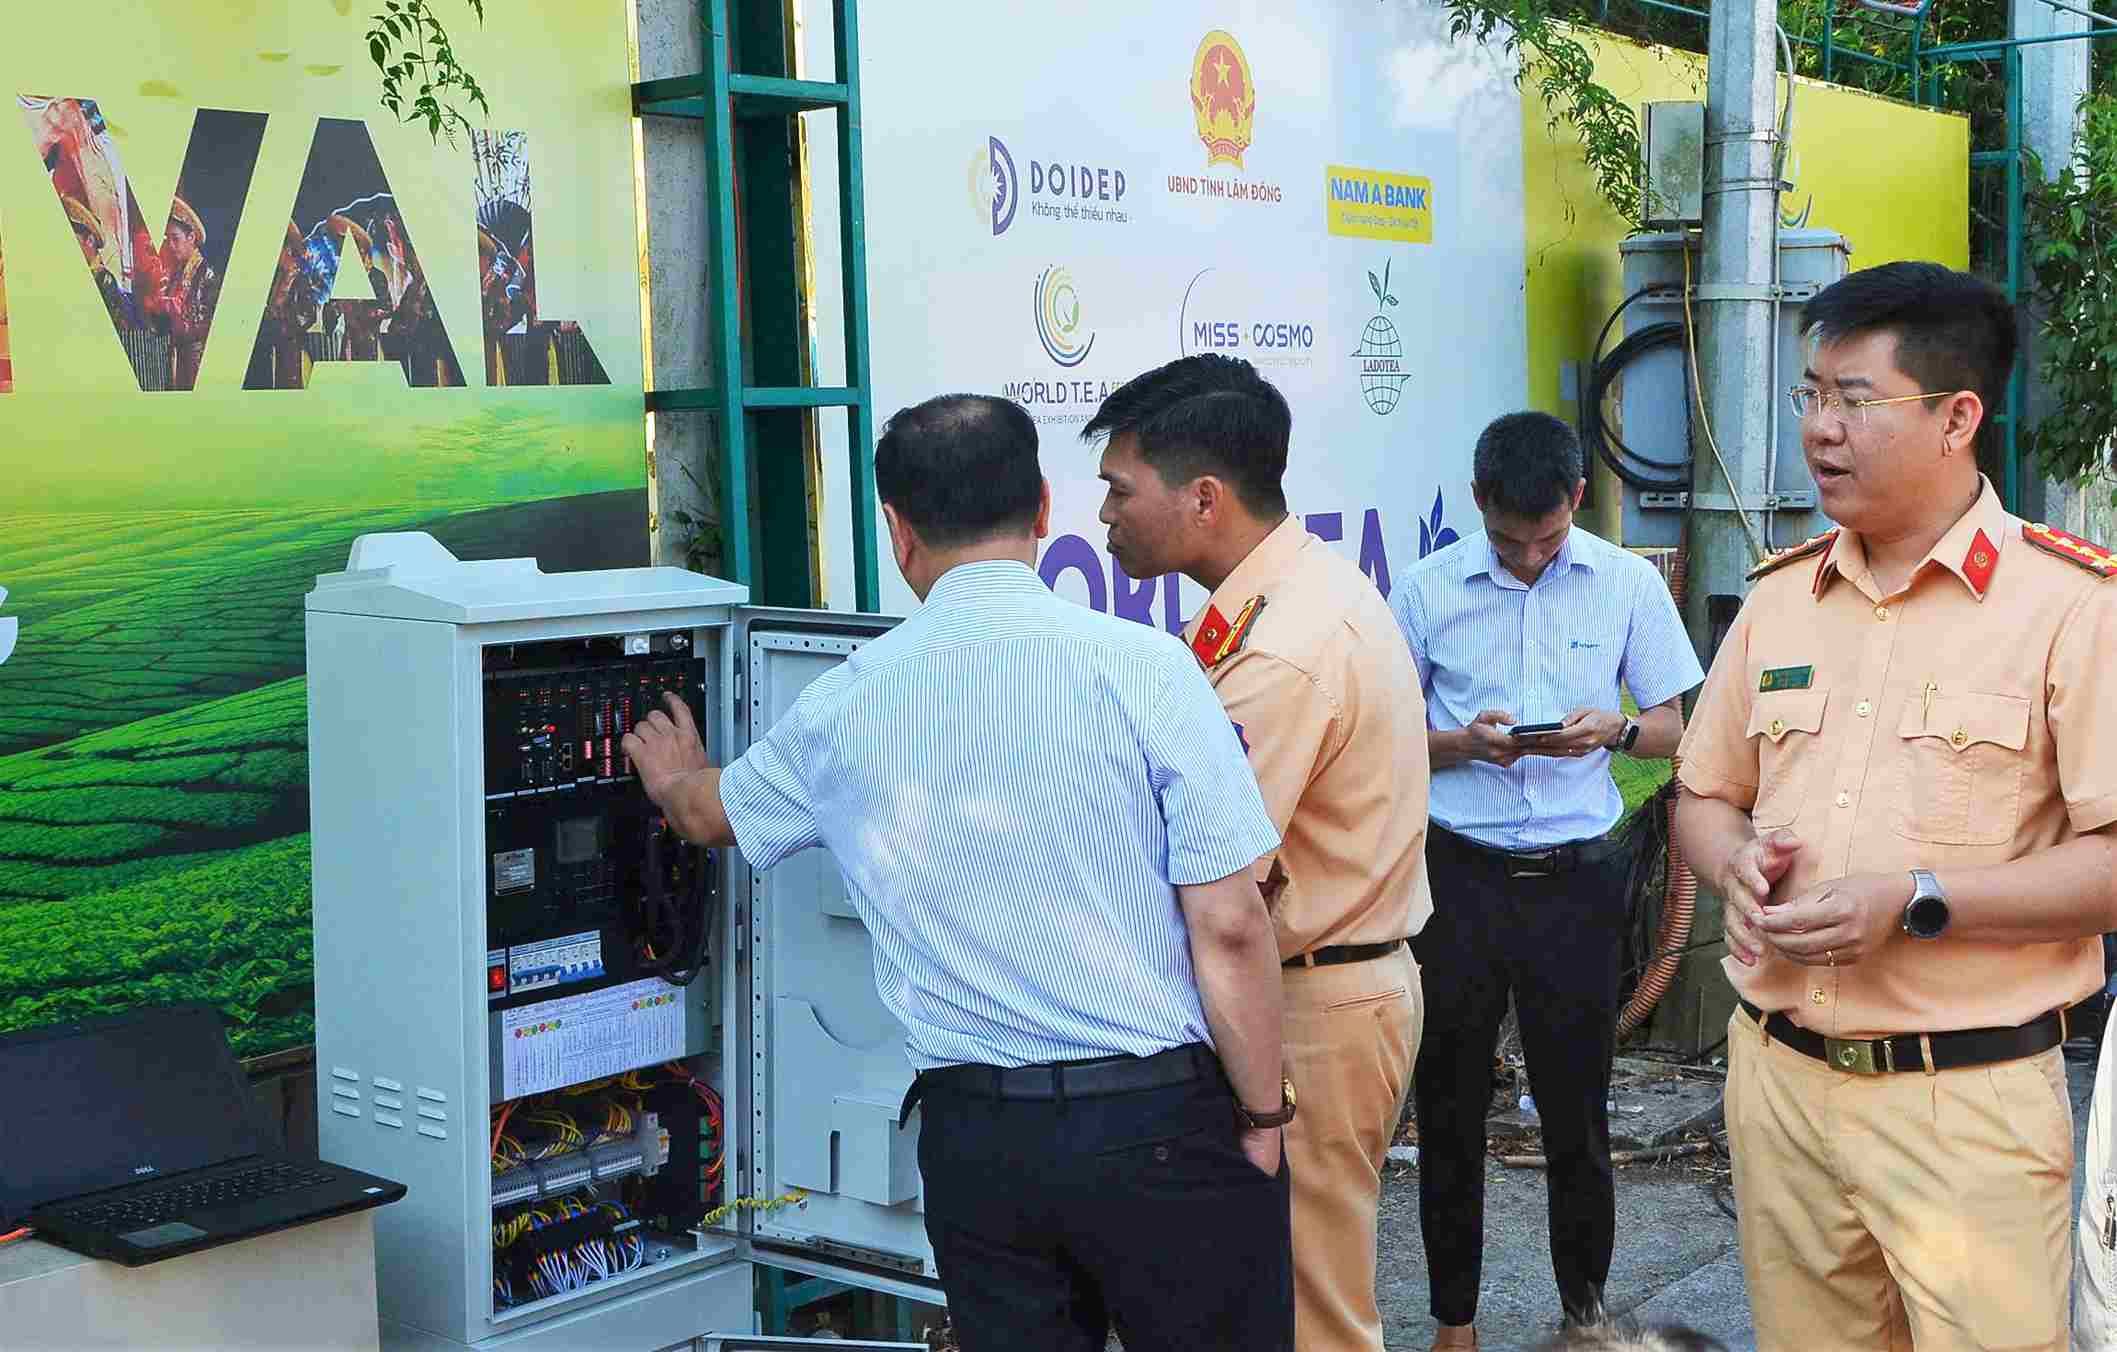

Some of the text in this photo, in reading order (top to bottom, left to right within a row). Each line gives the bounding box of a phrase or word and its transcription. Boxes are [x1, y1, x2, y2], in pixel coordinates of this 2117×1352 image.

[1030, 159, 1126, 202] DOIDEP
[1167, 175, 1198, 194] UBND
[1331, 176, 1427, 211] NAM A BANK
[1031, 200, 1062, 221] Không
[1106, 207, 1128, 223] nhau
[0, 92, 612, 392] VAL
[1193, 321, 1313, 349] MISS COSMO
[1363, 359, 1401, 373] LADOTEA
[1002, 381, 1067, 404] WORLD
[1038, 534, 1195, 637] ORL
